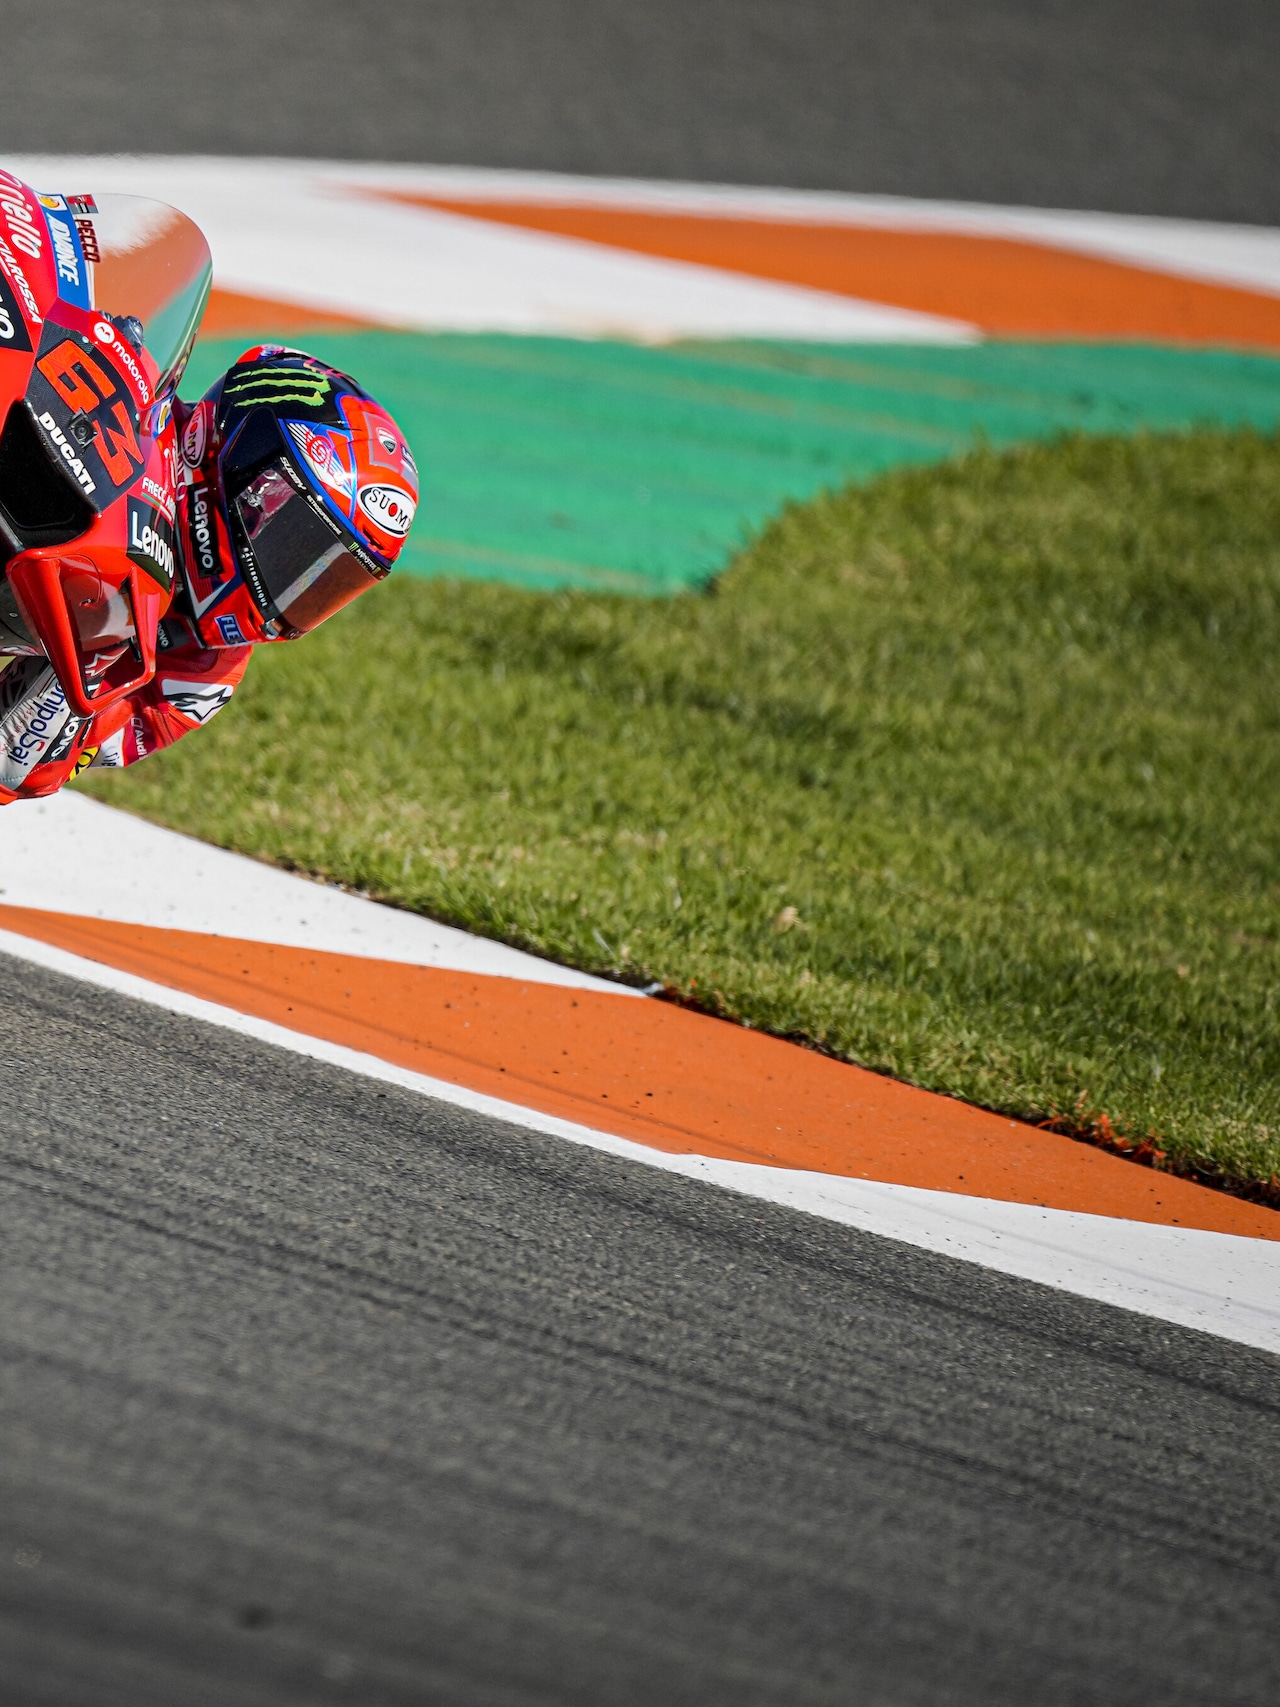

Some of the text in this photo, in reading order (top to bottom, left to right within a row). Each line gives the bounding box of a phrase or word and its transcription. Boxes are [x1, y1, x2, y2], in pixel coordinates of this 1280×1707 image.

[74, 219, 101, 263] PECCO
[112, 341, 150, 405] motorola
[36, 339, 145, 487] 63
[38, 411, 97, 495] DUCATI
[131, 511, 175, 579] Lenovo
[193, 487, 214, 569] Lenovo
